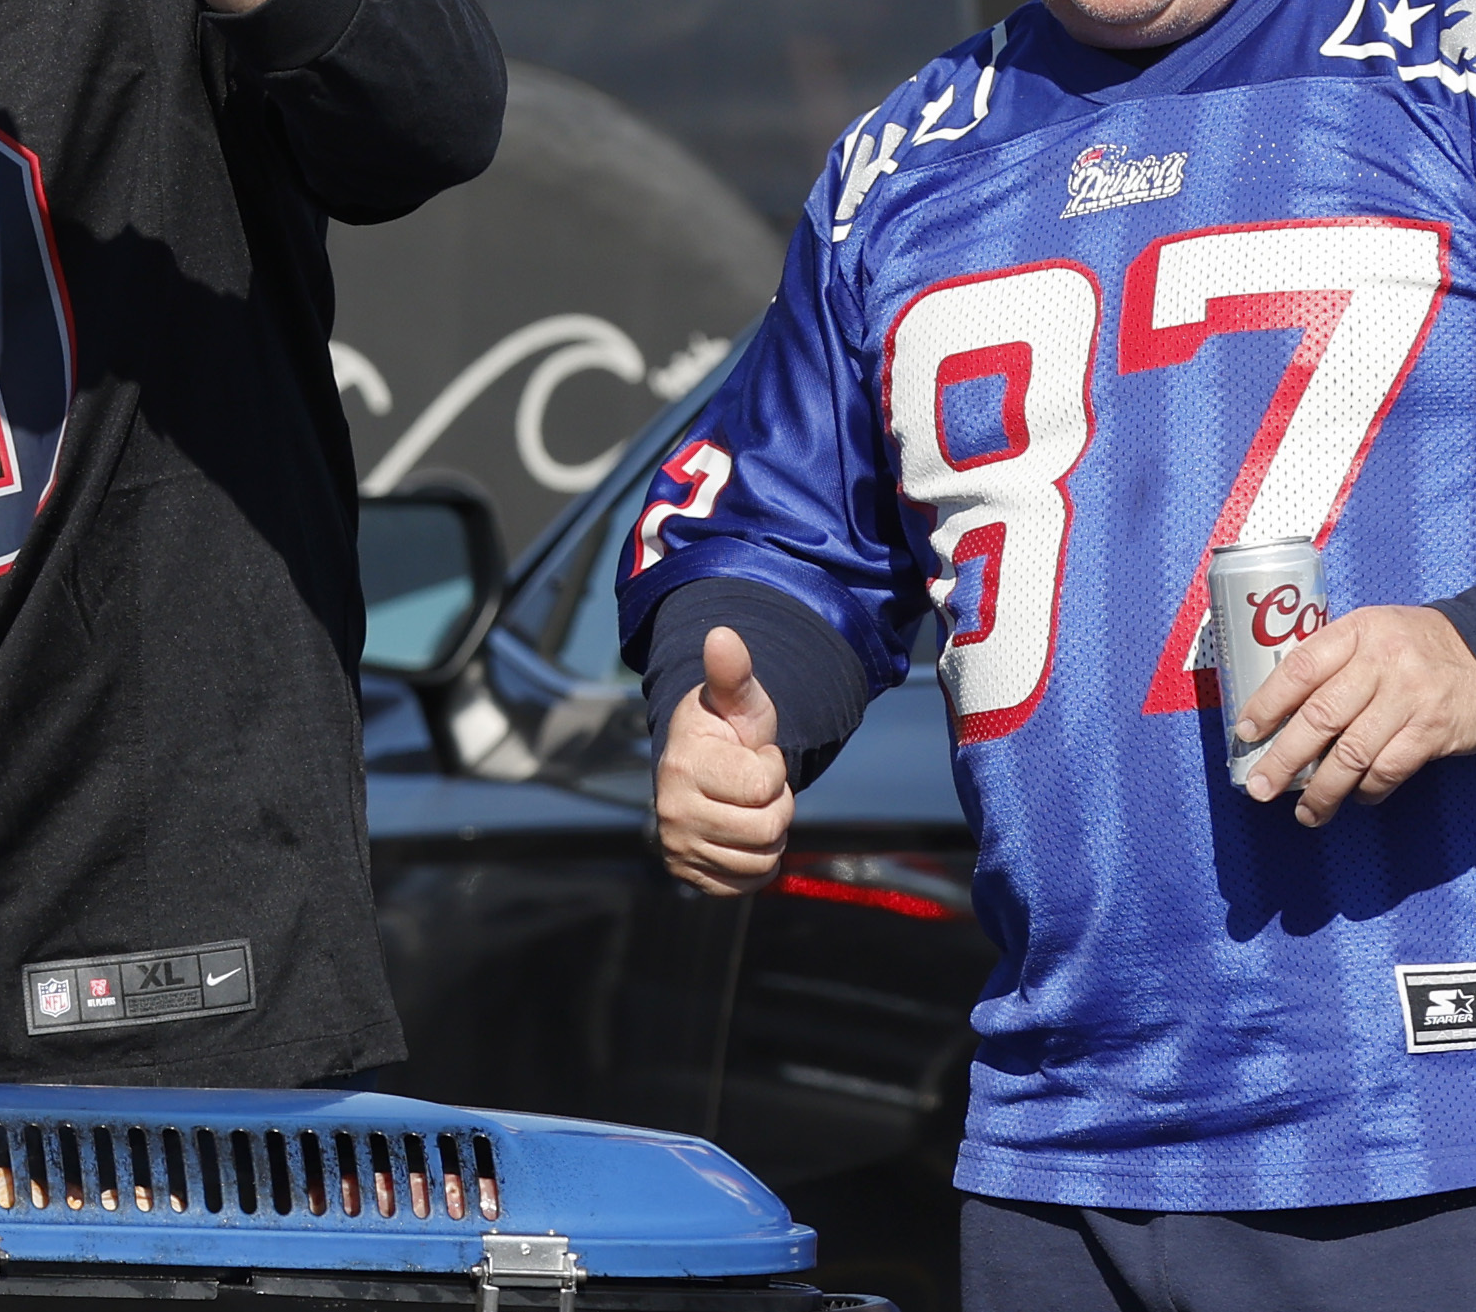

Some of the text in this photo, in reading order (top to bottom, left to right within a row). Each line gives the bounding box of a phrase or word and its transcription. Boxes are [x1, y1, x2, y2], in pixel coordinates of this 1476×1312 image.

[882, 217, 1451, 744] 87
[136, 962, 185, 990] XL
[44, 992, 68, 1012] NFL
[1424, 1013, 1474, 1026] STARTER
